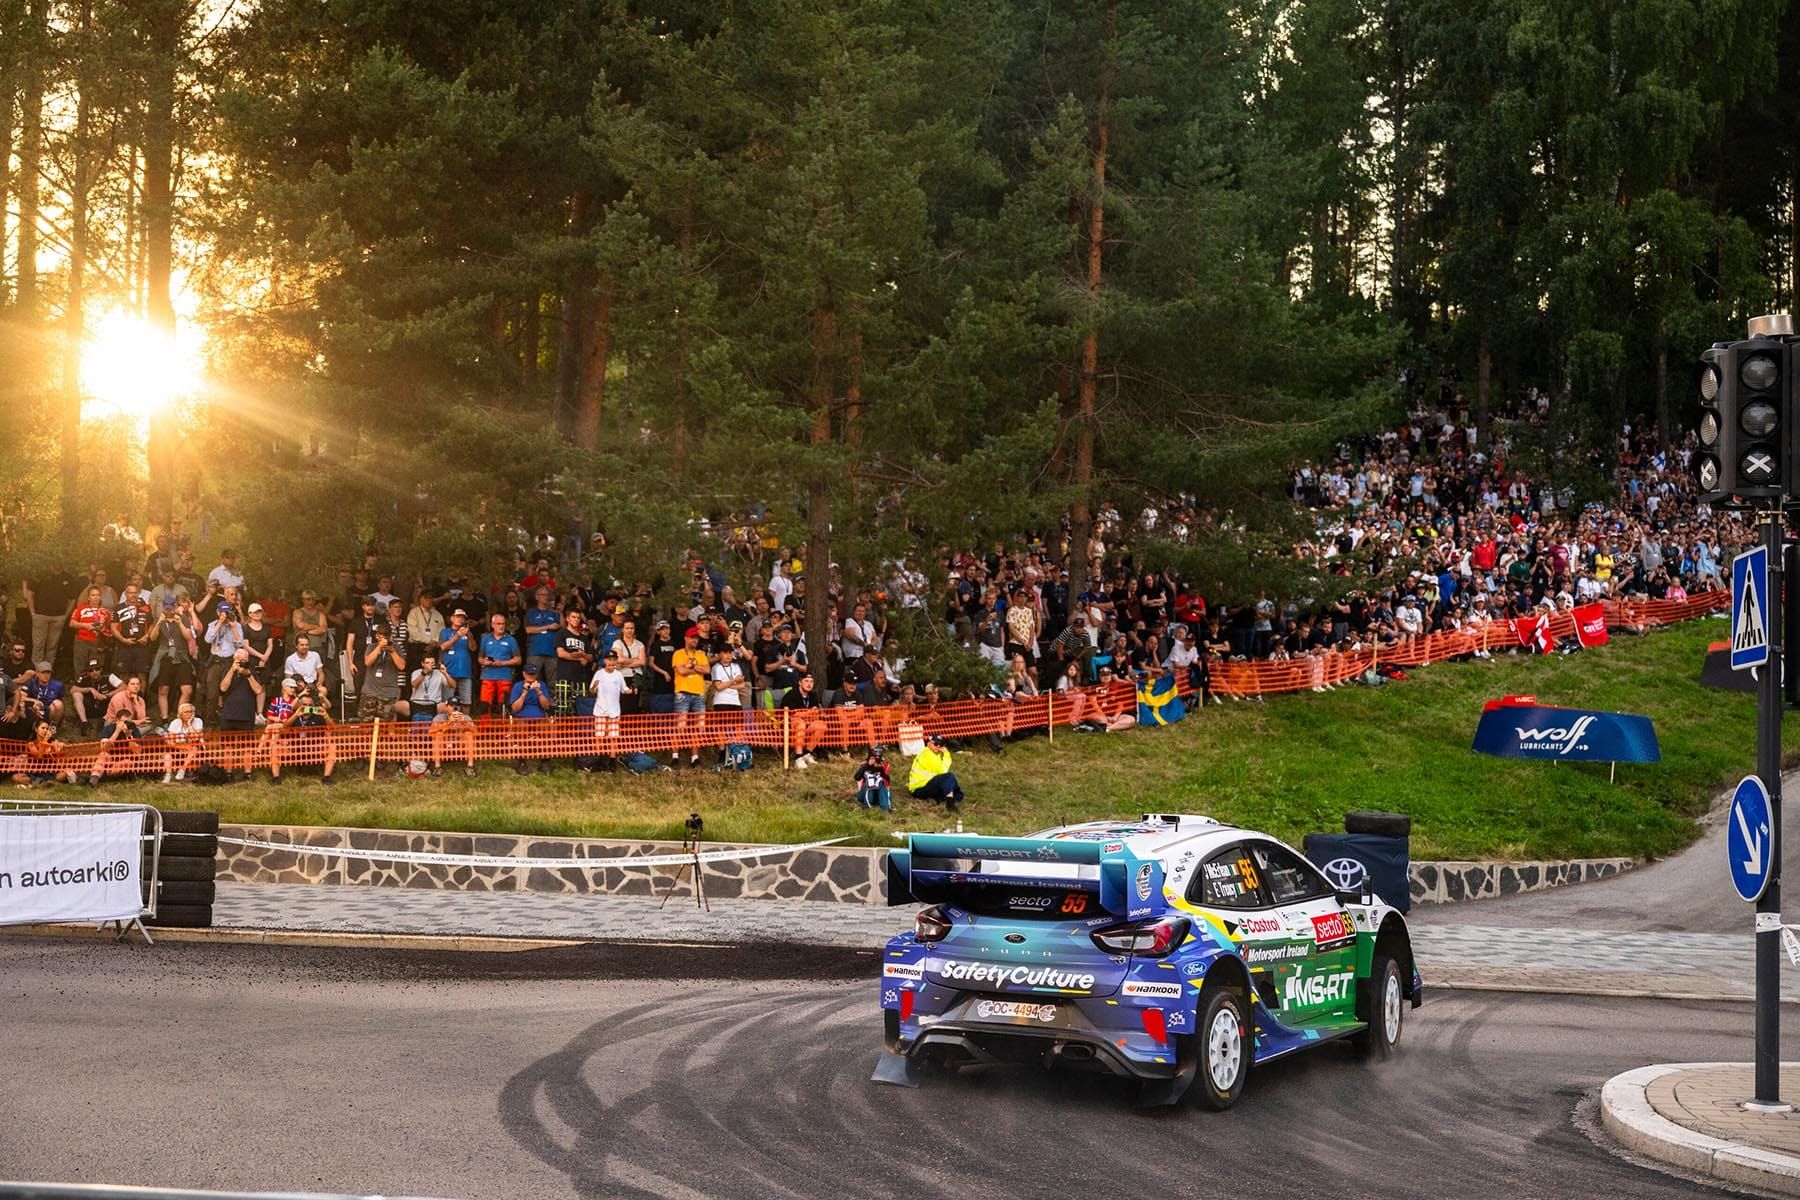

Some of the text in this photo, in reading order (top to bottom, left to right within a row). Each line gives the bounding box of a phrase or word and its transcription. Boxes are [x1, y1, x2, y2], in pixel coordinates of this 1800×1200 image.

[1519, 742, 1564, 751] LUBRICANTS
[1238, 858, 1259, 889] 55
[1008, 894, 1088, 914] secto 55
[1245, 917, 1281, 934] Castrol
[1247, 946, 1285, 962] Motorsport
[1285, 943, 1309, 957] Ireland
[940, 960, 1095, 988] SafetyCulture
